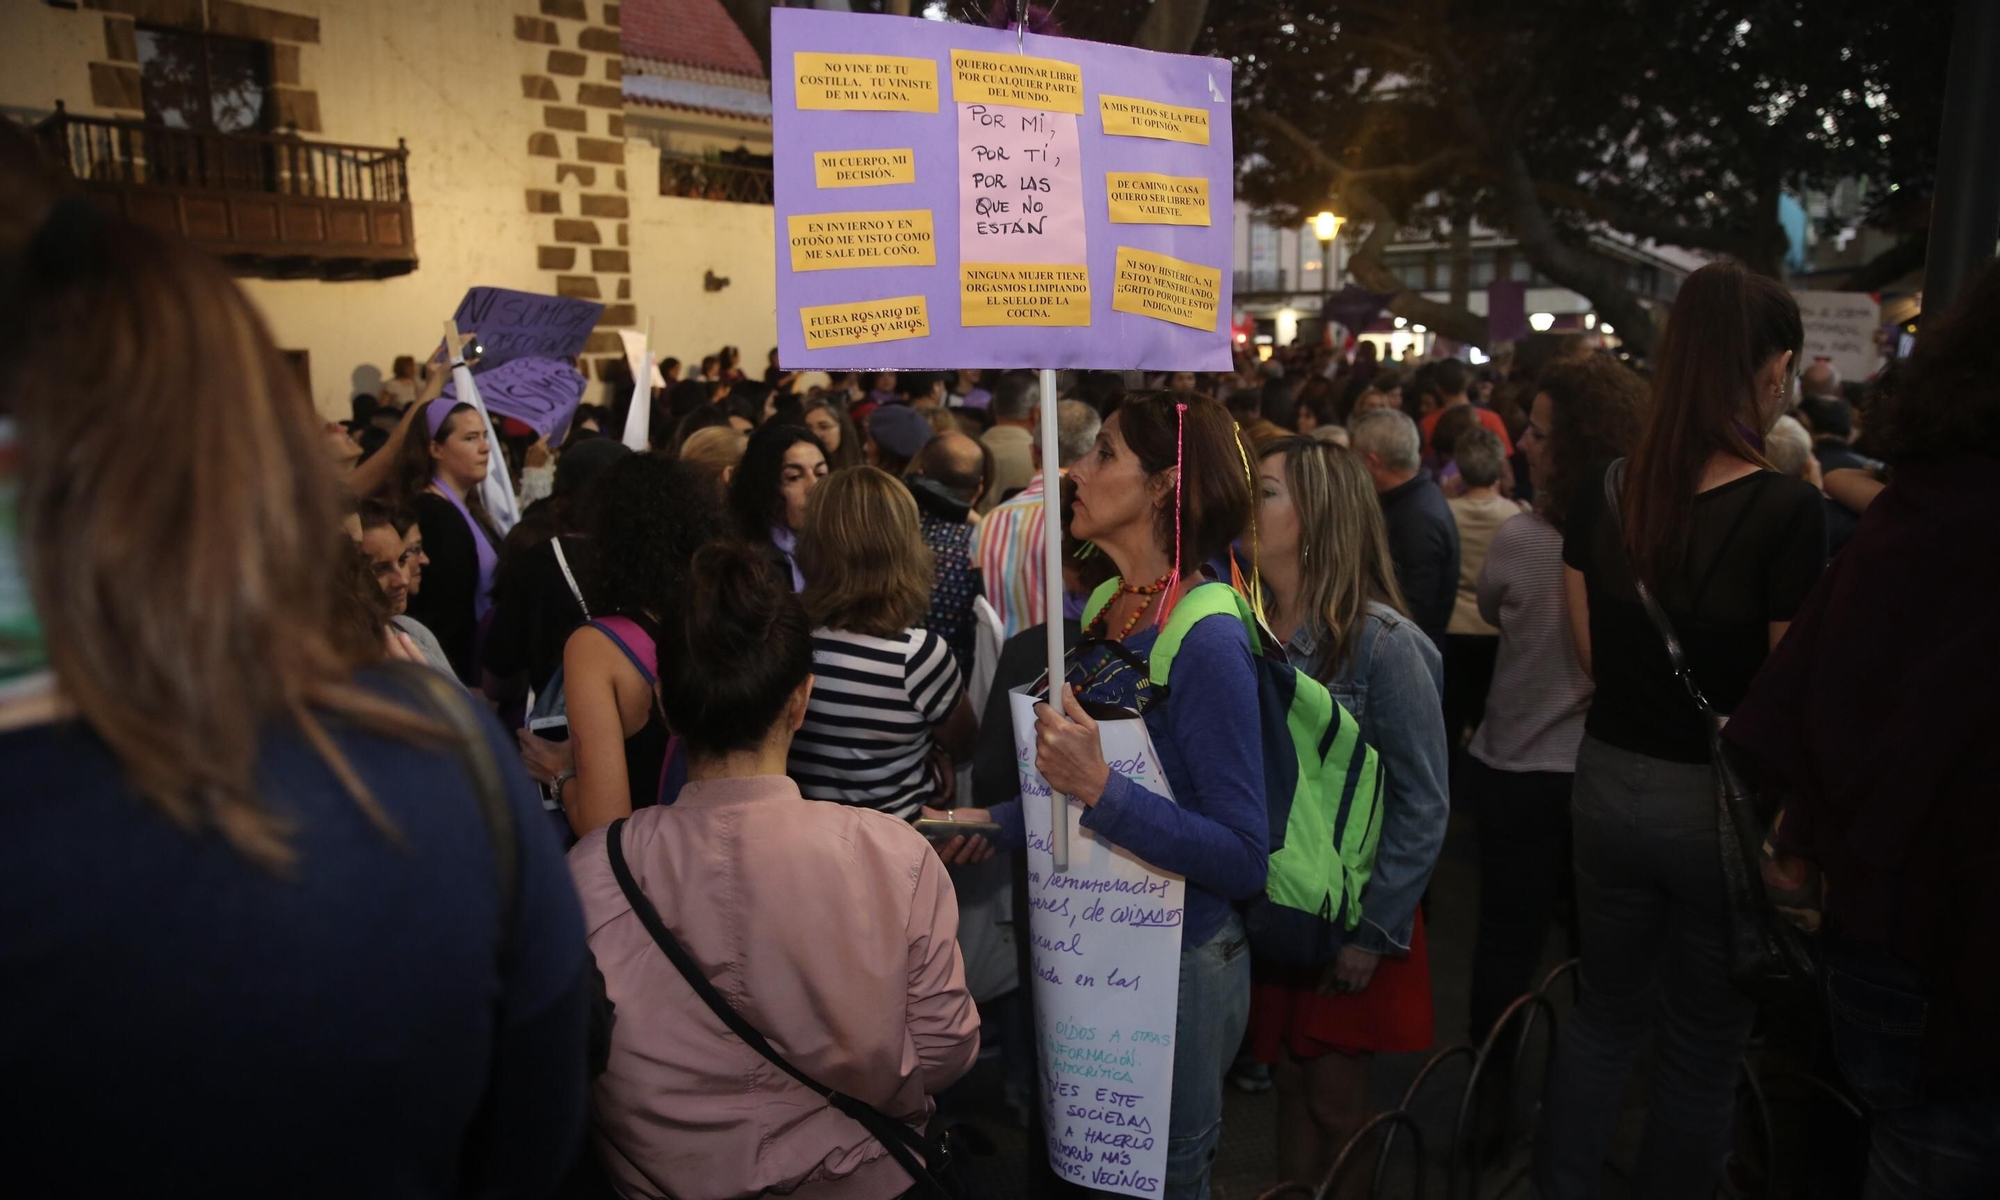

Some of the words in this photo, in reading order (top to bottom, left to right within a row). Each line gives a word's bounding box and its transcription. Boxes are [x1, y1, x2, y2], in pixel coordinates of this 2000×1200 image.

[825, 63, 842, 73] NO
[845, 64, 872, 73] VINE
[876, 65, 891, 74] DE
[894, 65, 909, 75] TU
[956, 58, 997, 71] QUIERO
[1000, 64, 1047, 78] CAMINAR
[1050, 71, 1079, 82] LIBRE
[870, 77, 885, 87] TU
[889, 78, 932, 90] VINISTE
[959, 72, 980, 82] POR
[983, 74, 1043, 90] CUALQUIER
[1045, 82, 1077, 94] PARTE
[826, 90, 840, 99] DE
[844, 90, 859, 100] MI
[861, 90, 910, 101] VAGINA.
[988, 87, 1009, 98] DEL
[1011, 90, 1052, 103] MUNDO.
[967, 105, 1006, 129] POR
[1102, 102, 1109, 110] A
[1111, 102, 1129, 112] MIS
[1130, 104, 1158, 116] PELOS
[1159, 110, 1169, 119] SE
[1171, 112, 1182, 122] LA
[1184, 114, 1207, 125] PELA
[1131, 116, 1143, 126] TU
[1144, 120, 1182, 133] OPINIÓN.
[821, 158, 836, 168] MI
[892, 155, 907, 165] MI
[971, 145, 1011, 162] POR
[836, 167, 895, 180] DECISIÓN.
[972, 172, 1007, 189] POR
[1020, 176, 1051, 193] LAS
[1117, 180, 1131, 189] DE
[1132, 180, 1168, 191] CAMINO
[1169, 184, 1175, 192] A
[1176, 185, 1199, 195] CASA
[975, 197, 1010, 218] QUE
[1022, 194, 1043, 214] NO
[1111, 192, 1148, 203] QUIERO
[1149, 193, 1166, 203] SER
[1167, 195, 1191, 206] LIBRE
[1192, 198, 1206, 207] NO
[1138, 205, 1183, 217] VALIENTE.
[808, 223, 824, 233] EN
[827, 220, 884, 232] INVIERNO
[887, 220, 895, 229] Y
[897, 219, 913, 229] EN
[977, 215, 1048, 235] ESTÁN
[792, 234, 834, 247] OTOÑO
[837, 235, 855, 245] ME
[857, 233, 893, 244] VISTO
[895, 232, 930, 242] COMO
[805, 250, 823, 259] ME
[826, 248, 855, 259] SALE
[858, 247, 881, 257] DEL
[883, 244, 920, 256] COÑO.
[967, 271, 1016, 280] NINGUNA
[1018, 271, 1054, 280] MUJER
[1056, 272, 1086, 281] TIENE
[1121, 271, 1153, 284] ESTOY
[1126, 259, 1137, 269] NI
[1139, 261, 1158, 273] SOY
[1203, 278, 1212, 288] NI
[966, 283, 1027, 293] ORGASMOS
[1029, 284, 1087, 293] LIMPIANDO
[986, 296, 1000, 305] EL
[1002, 296, 1037, 305] SUELO
[1040, 296, 1054, 305] DE
[1056, 297, 1070, 306] LA
[1142, 299, 1193, 319] INDIGNADA!!
[1156, 290, 1187, 305] PORQUE
[1188, 299, 1216, 312] ESTOY
[811, 314, 848, 326] FUERA
[851, 307, 903, 323] ROSARIO
[905, 306, 920, 316] DE
[1006, 309, 1051, 318] COCINA.
[809, 325, 869, 339] NUESTROS
[871, 318, 926, 334] OVARIOS.
[1082, 898, 1105, 922] de
[1075, 974, 1094, 987] en
[1107, 968, 1141, 991] las
[1055, 1015, 1097, 1040] OÍDOS
[1109, 1030, 1120, 1043] A
[1096, 1088, 1145, 1108] ESTE
[1066, 1104, 1152, 1135] SOCIEDAD
[1065, 1126, 1074, 1137] A
[1085, 1127, 1154, 1151] HACERLO
[1092, 1166, 1159, 1192] VECINOS
